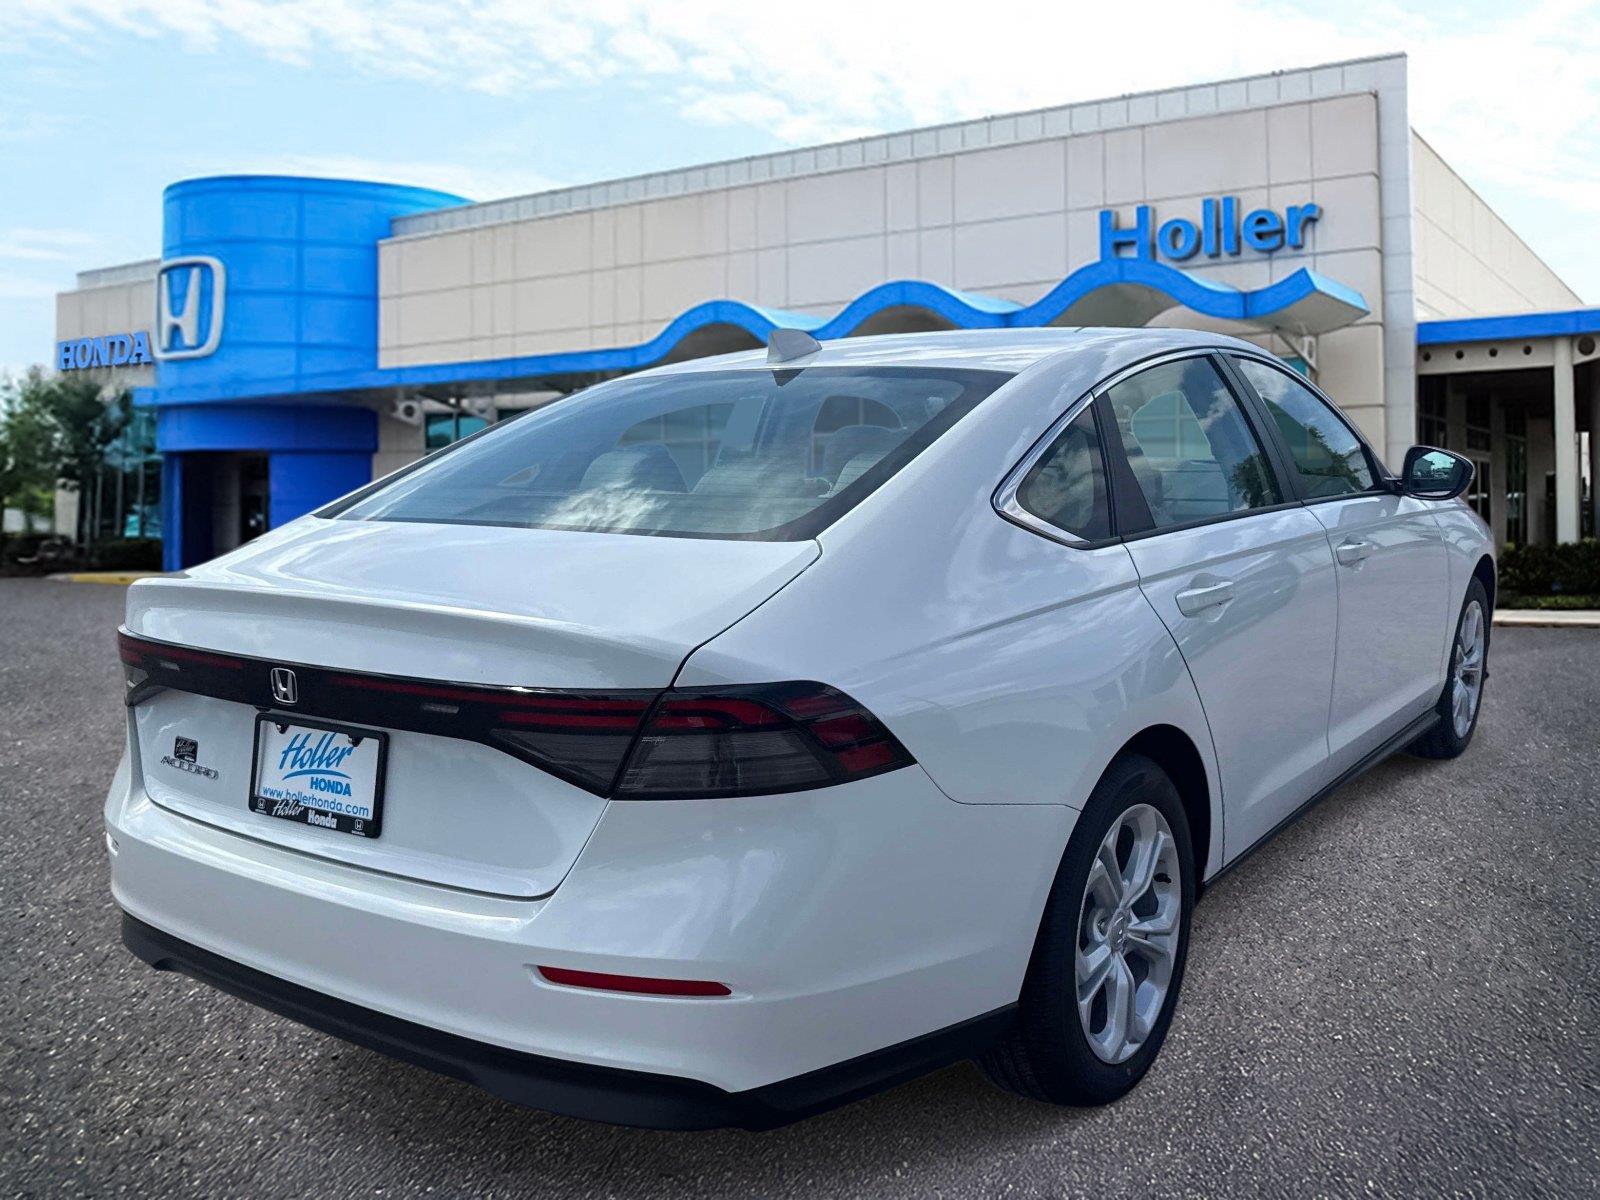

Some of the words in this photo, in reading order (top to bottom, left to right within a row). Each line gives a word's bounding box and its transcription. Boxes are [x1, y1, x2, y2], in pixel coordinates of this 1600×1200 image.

[1099, 196, 1322, 262] Holler
[57, 331, 153, 371] HONDA
[278, 732, 355, 770] Holler
[310, 777, 352, 796] HONDA
[307, 809, 338, 829] Honda
